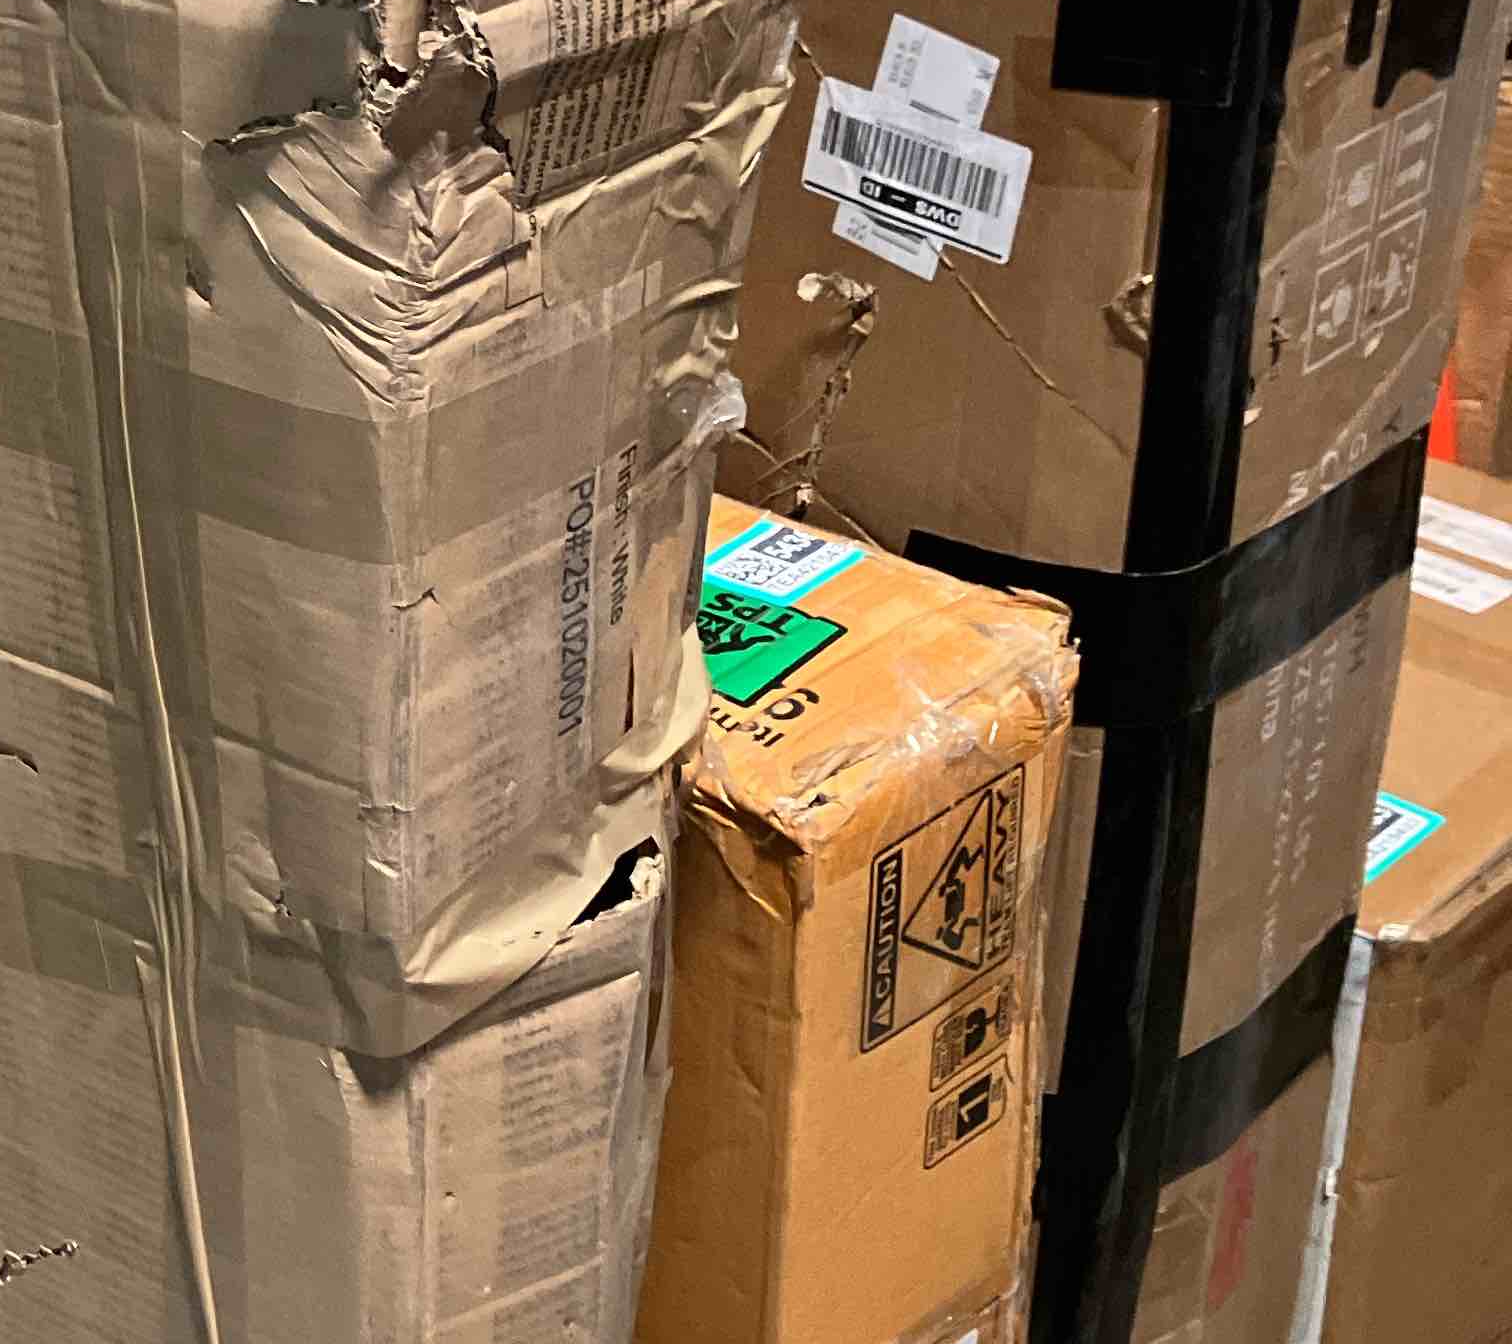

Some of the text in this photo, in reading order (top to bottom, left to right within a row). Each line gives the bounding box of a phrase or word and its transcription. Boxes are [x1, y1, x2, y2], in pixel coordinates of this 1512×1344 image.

[863, 180, 883, 199] ID
[914, 199, 962, 229] DWS
[613, 444, 637, 528] Finish
[557, 476, 595, 738] PO#:251020001
[609, 543, 630, 626] White
[706, 592, 795, 636] TPS
[987, 790, 1008, 961] HEAVY
[875, 858, 899, 1000] CAUTION
